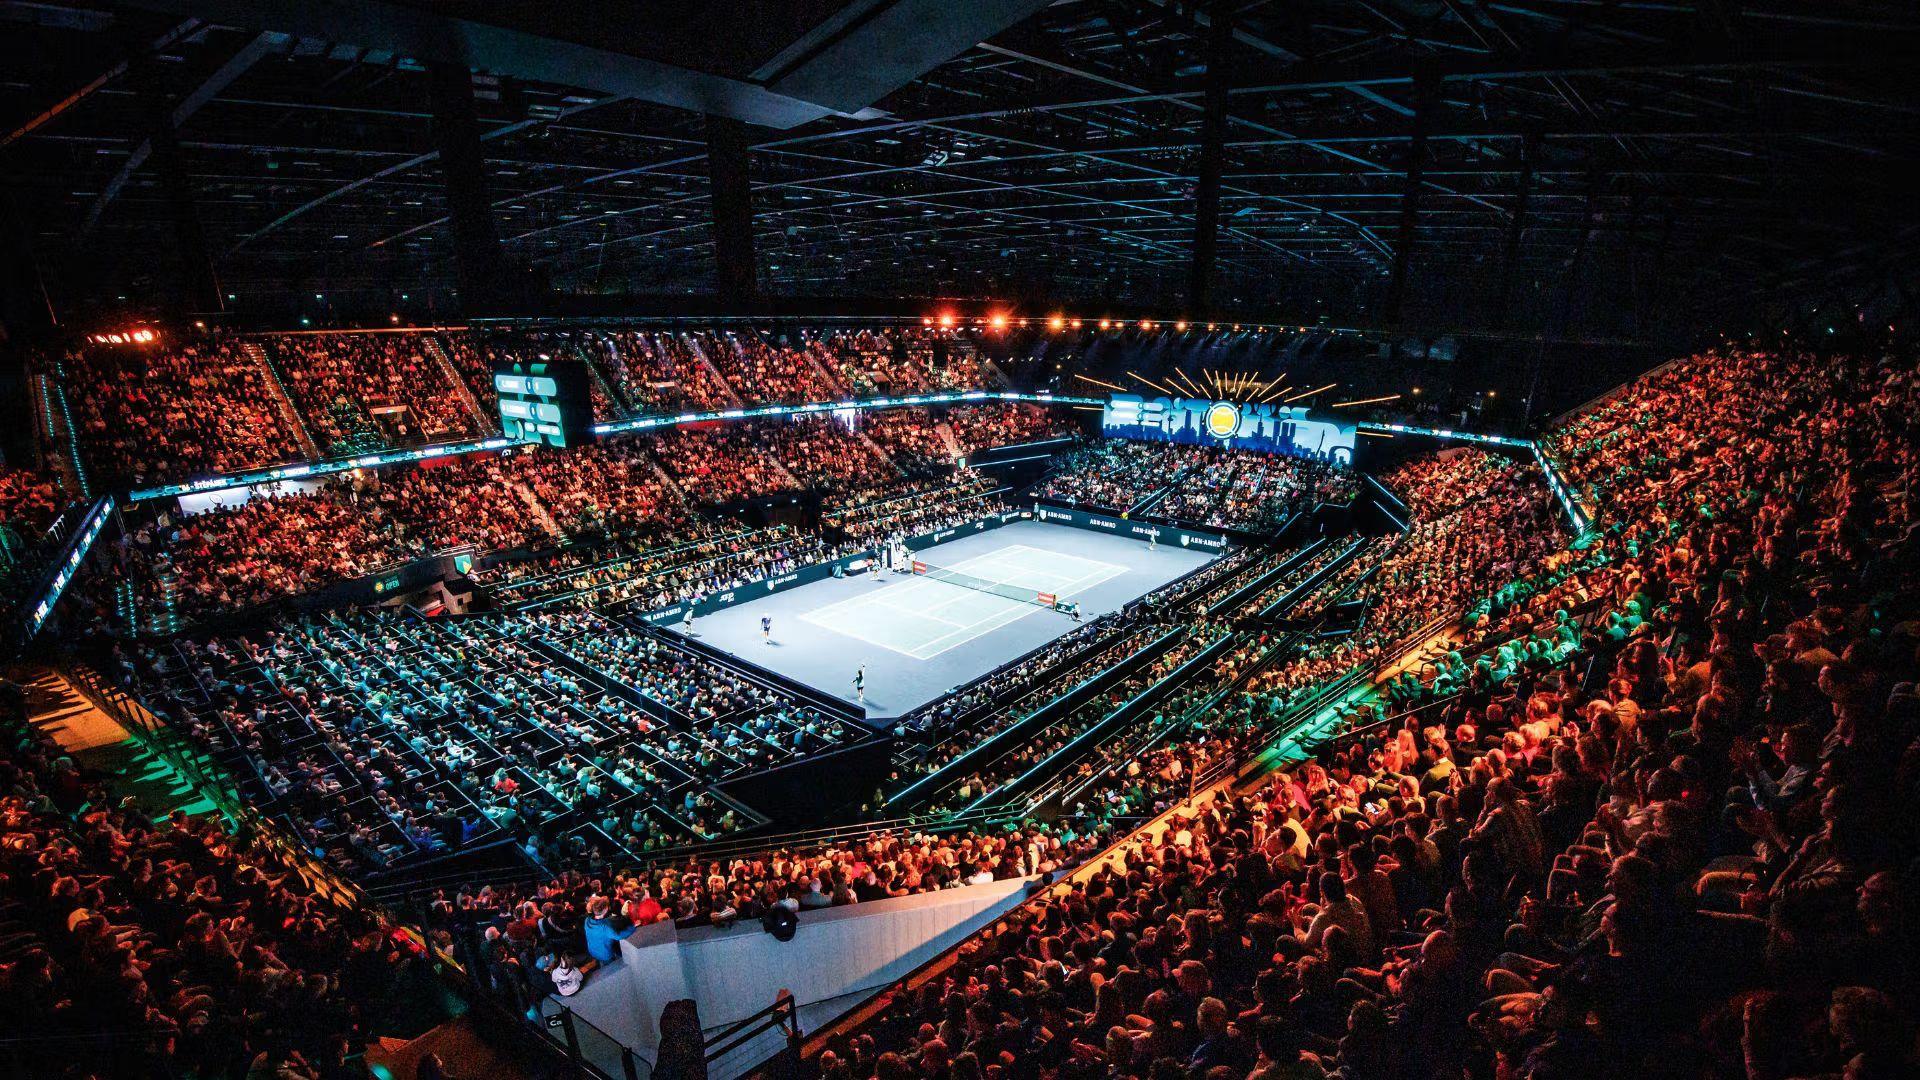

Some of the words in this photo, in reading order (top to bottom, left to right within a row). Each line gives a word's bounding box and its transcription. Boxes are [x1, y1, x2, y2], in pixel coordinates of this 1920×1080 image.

[1089, 518, 1116, 529] ABN-AMRO
[1190, 537, 1221, 548] ABN-AMRO
[385, 579, 399, 590] OPEN
